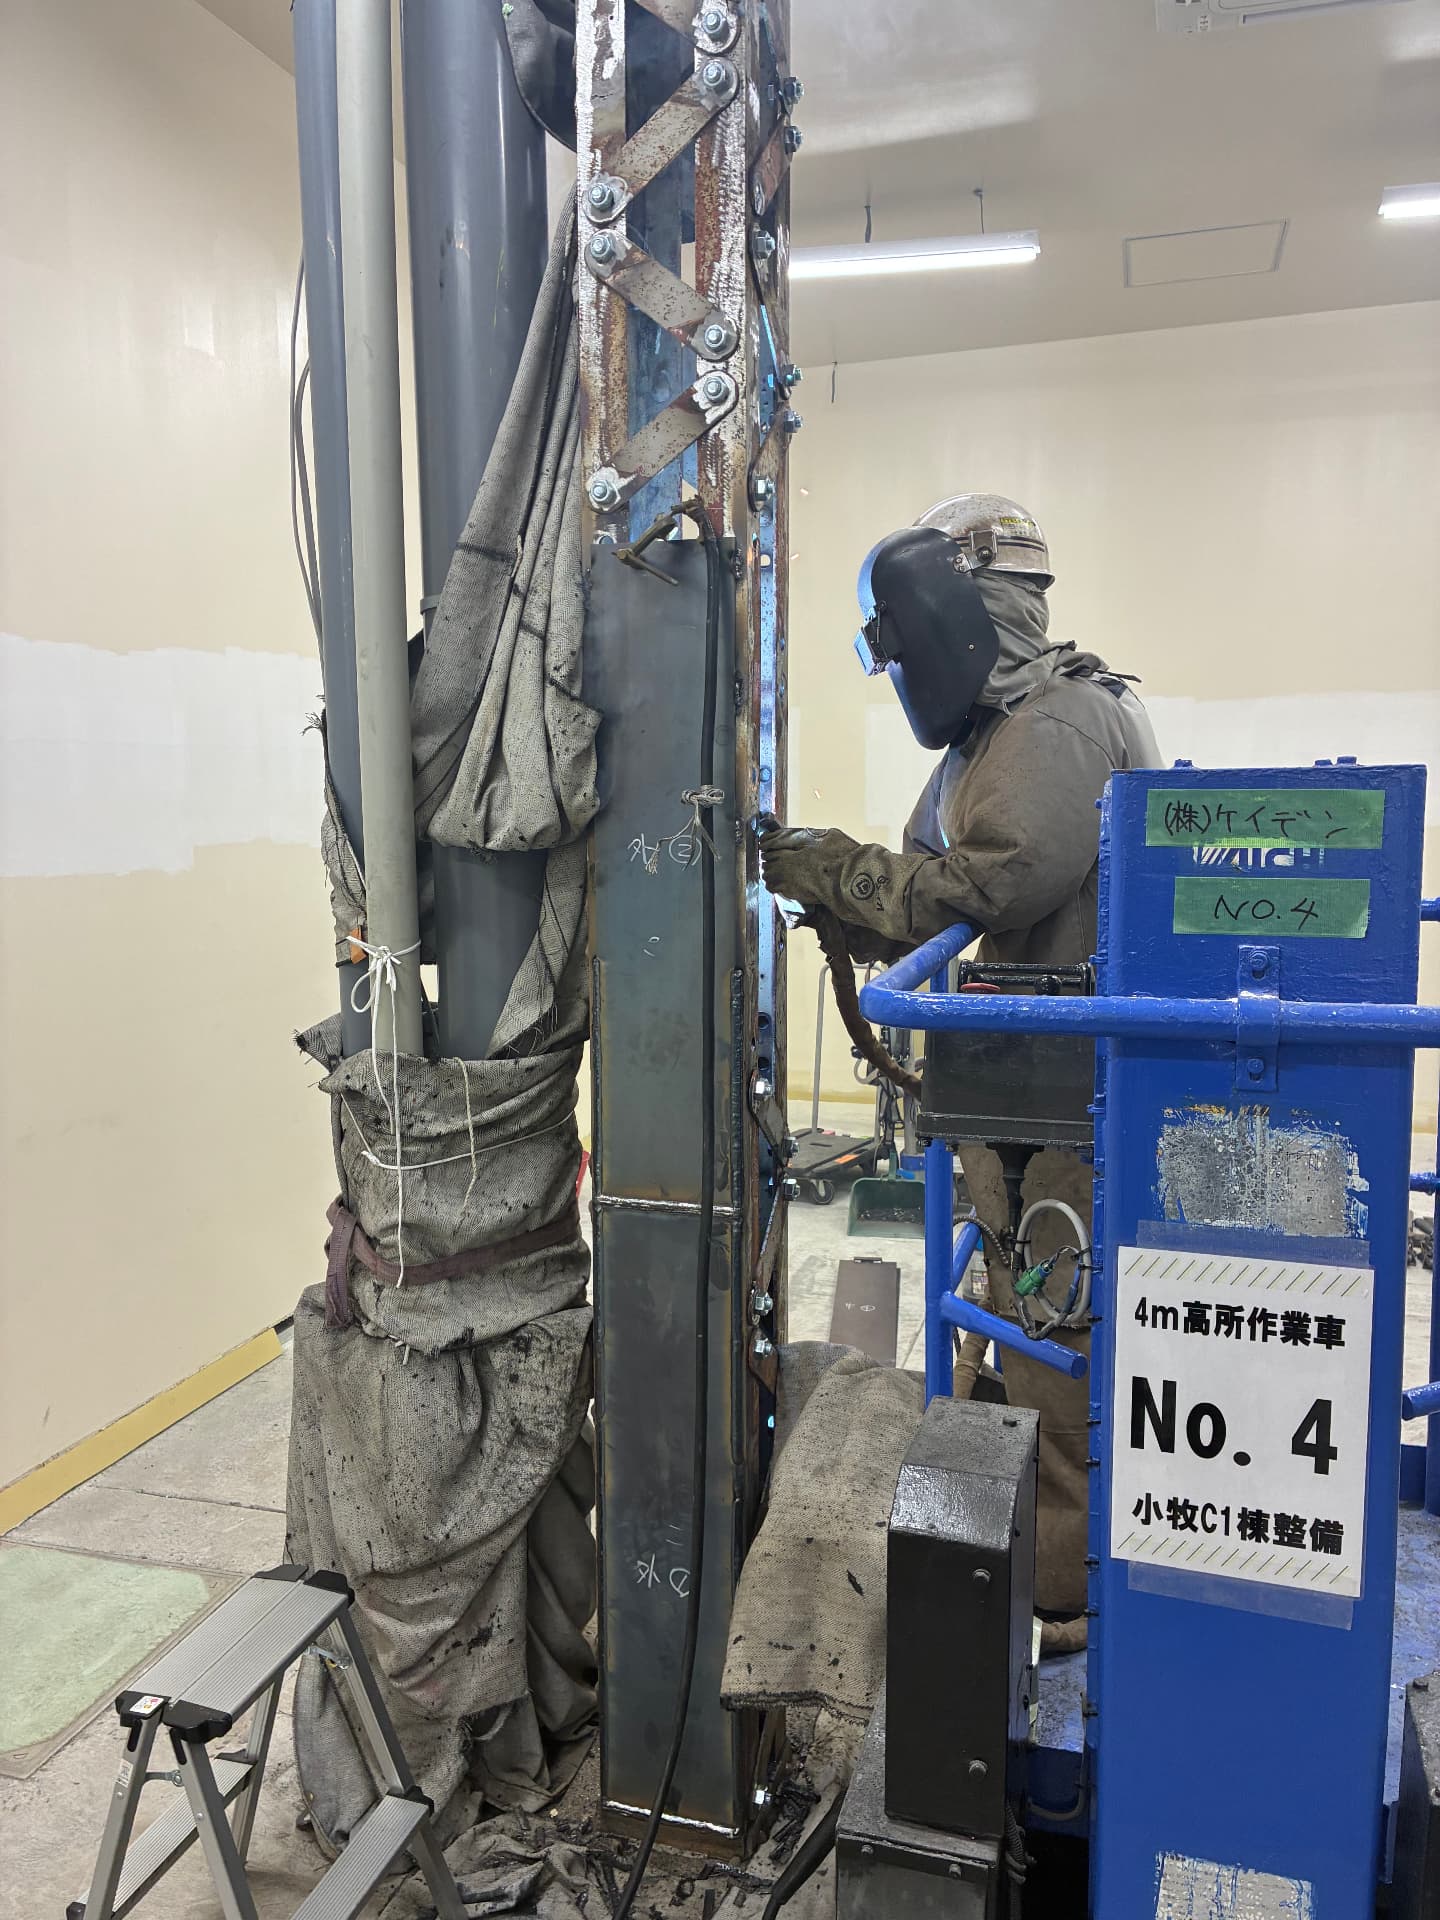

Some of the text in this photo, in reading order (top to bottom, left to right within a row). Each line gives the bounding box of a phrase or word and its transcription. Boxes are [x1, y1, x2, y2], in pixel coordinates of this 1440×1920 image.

[1134, 1297, 1346, 1350] 4m高所作業車
[1130, 1376, 1338, 1475] No. 4
[1132, 1492, 1344, 1556] 小牧C1棟整備
